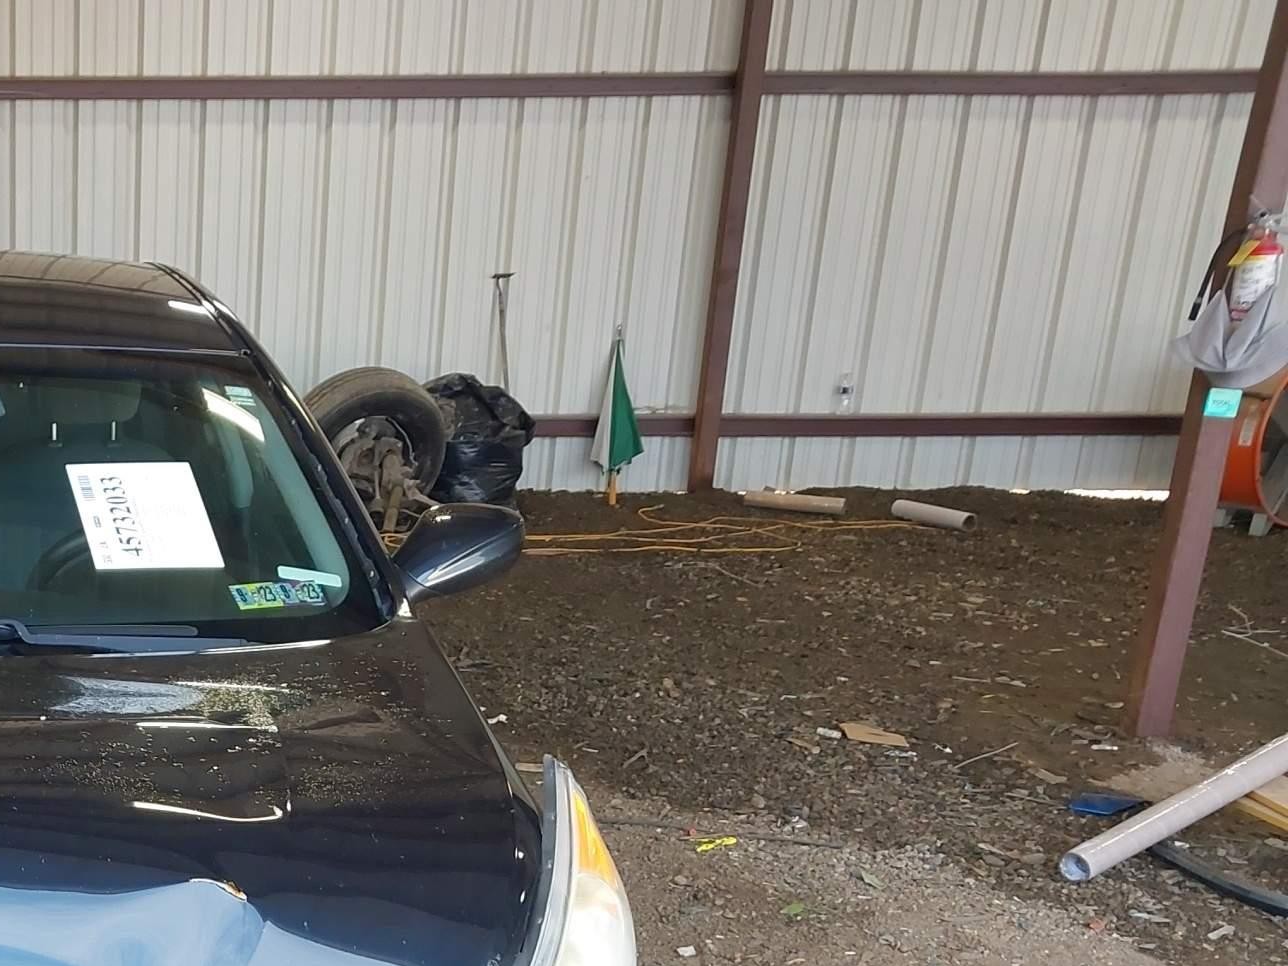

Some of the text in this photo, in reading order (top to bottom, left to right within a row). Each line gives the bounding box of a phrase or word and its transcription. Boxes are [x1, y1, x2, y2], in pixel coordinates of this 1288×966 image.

[100, 476, 143, 557] 45732033
[257, 585, 277, 602] 23
[300, 583, 320, 600] 23
